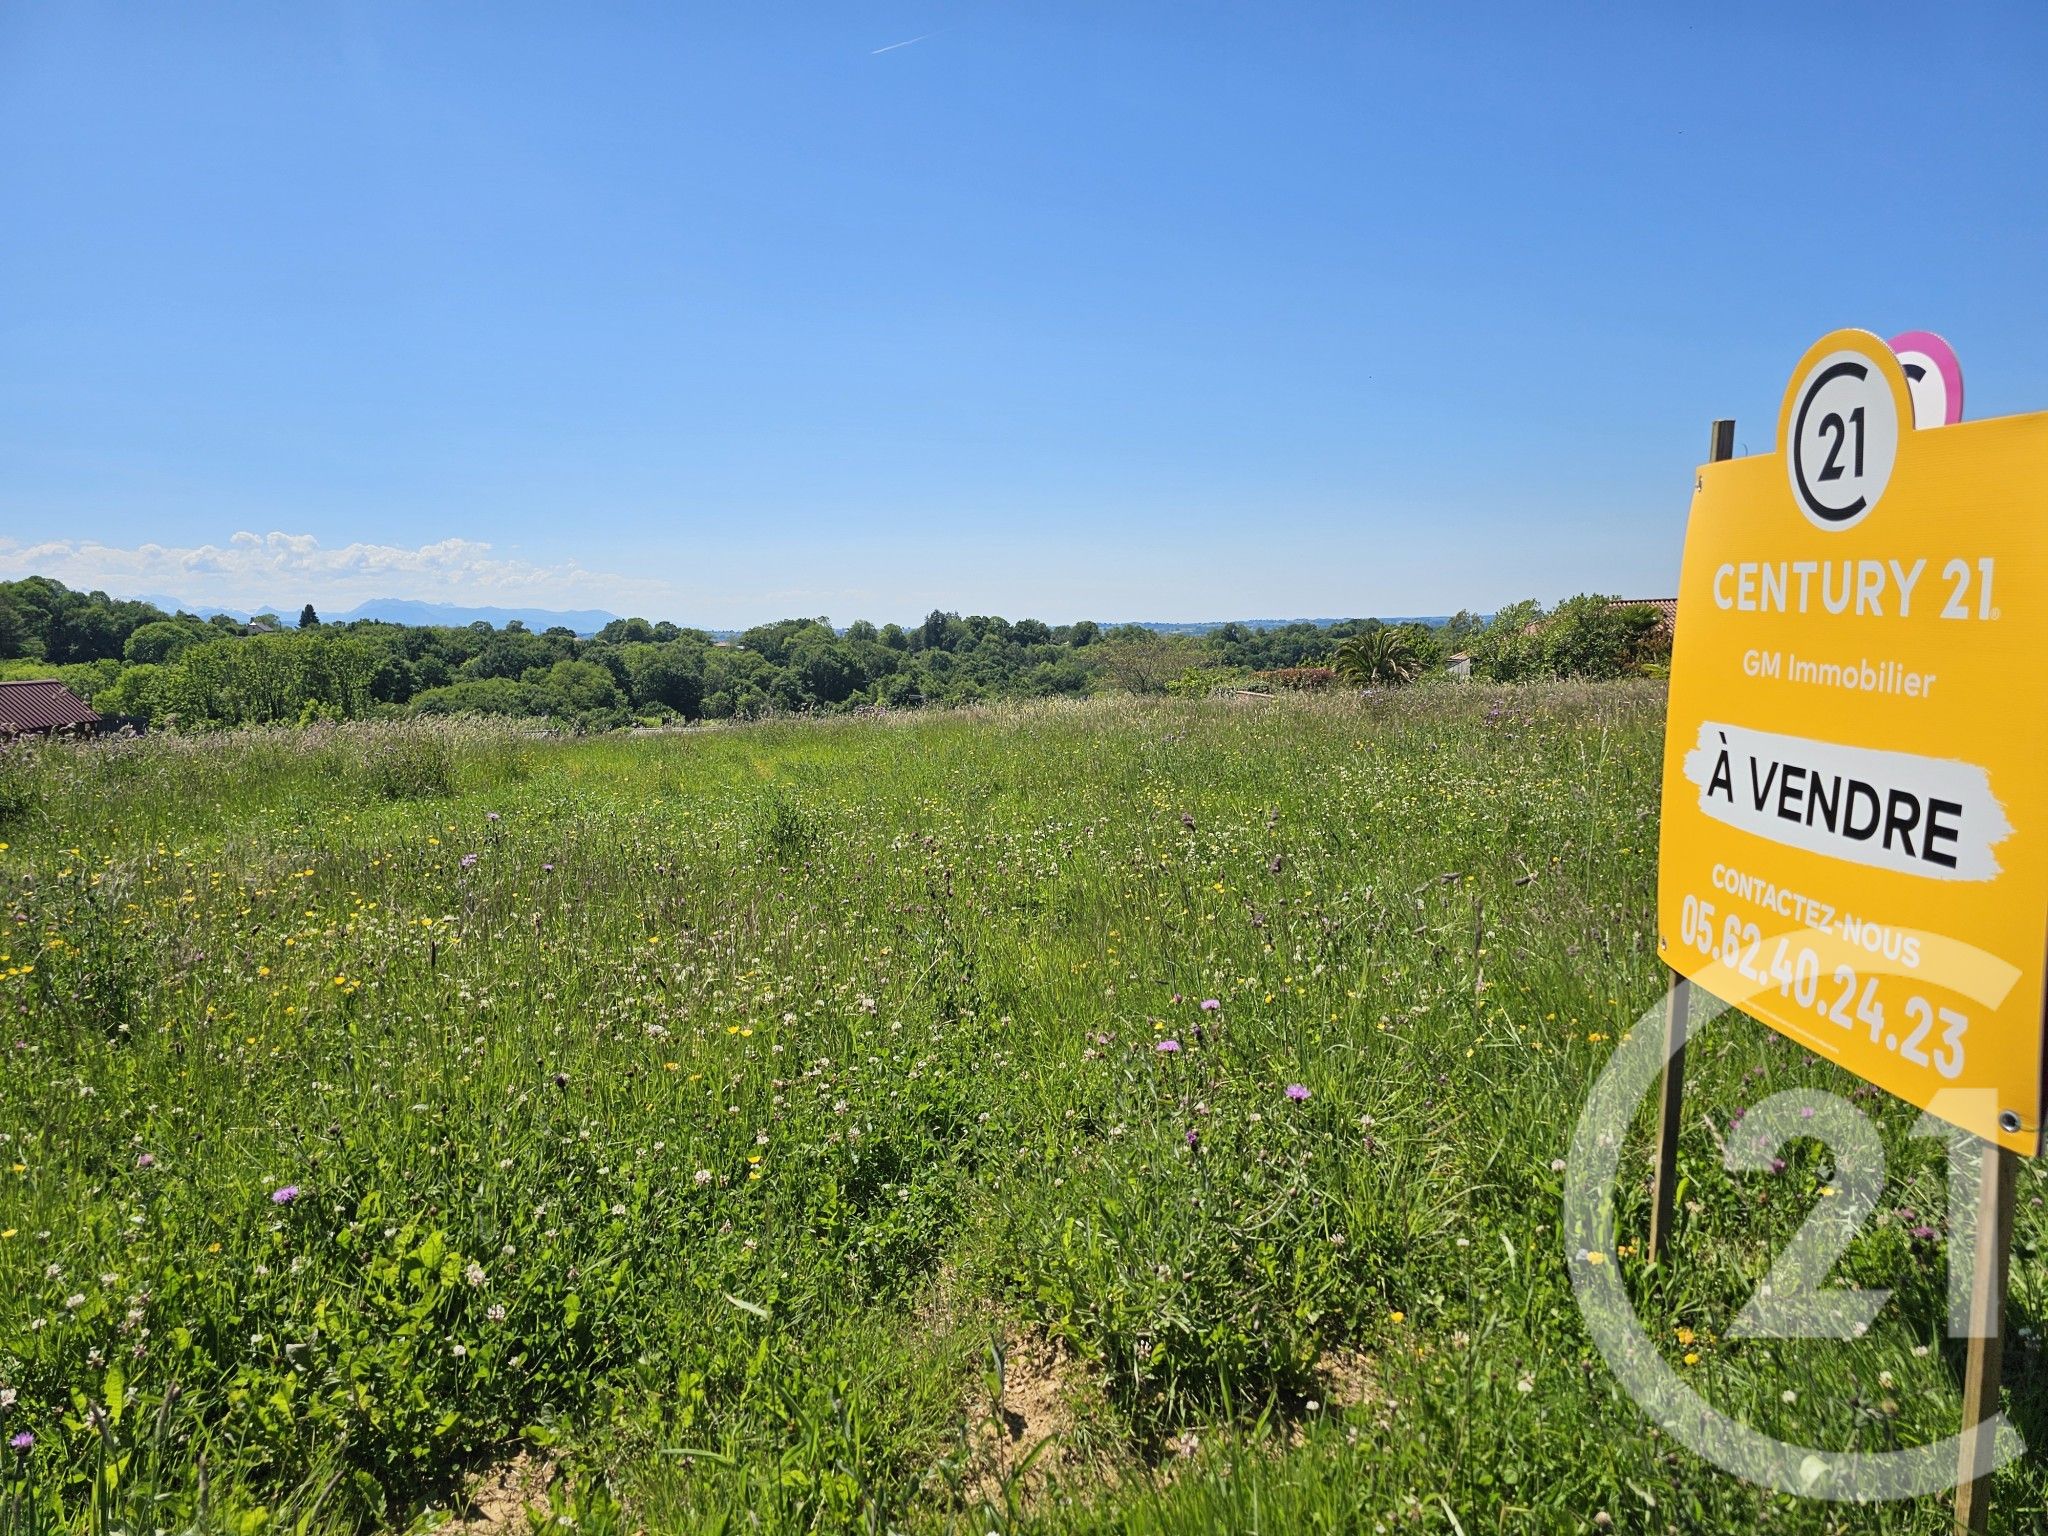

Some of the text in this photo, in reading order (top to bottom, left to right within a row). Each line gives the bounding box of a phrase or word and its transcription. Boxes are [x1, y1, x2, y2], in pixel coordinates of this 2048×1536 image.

[1713, 559, 1927, 618] CENTURY
[1743, 649, 1937, 698] GM Immobilier
[1707, 731, 1963, 869] À VENDRE
[1712, 863, 1921, 969] CONTACTEZ-NOUS
[1681, 894, 1969, 1080] 05.62.40.24.23
